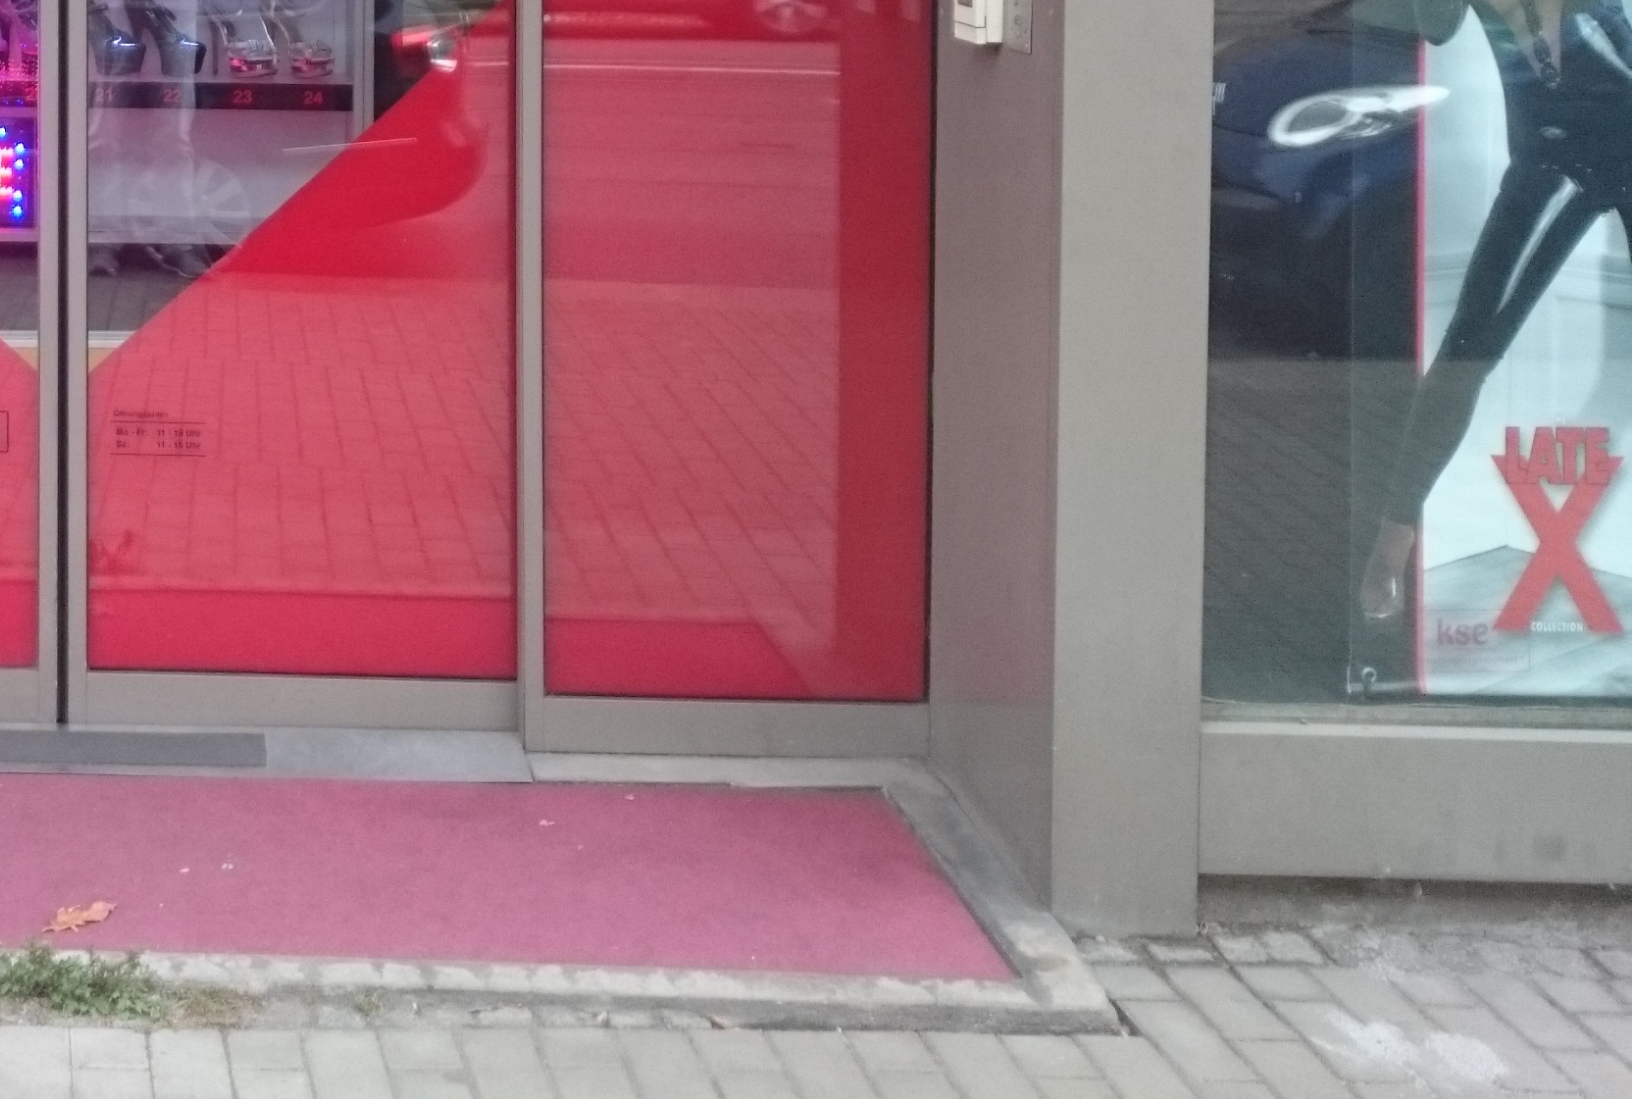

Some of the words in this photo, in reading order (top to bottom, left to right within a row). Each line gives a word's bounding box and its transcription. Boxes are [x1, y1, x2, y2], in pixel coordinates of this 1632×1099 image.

[163, 89, 182, 102] 22
[233, 90, 252, 104] 23
[305, 91, 323, 105] 24
[1504, 426, 1610, 486] LATE
[1530, 621, 1584, 633] COLLECTION
